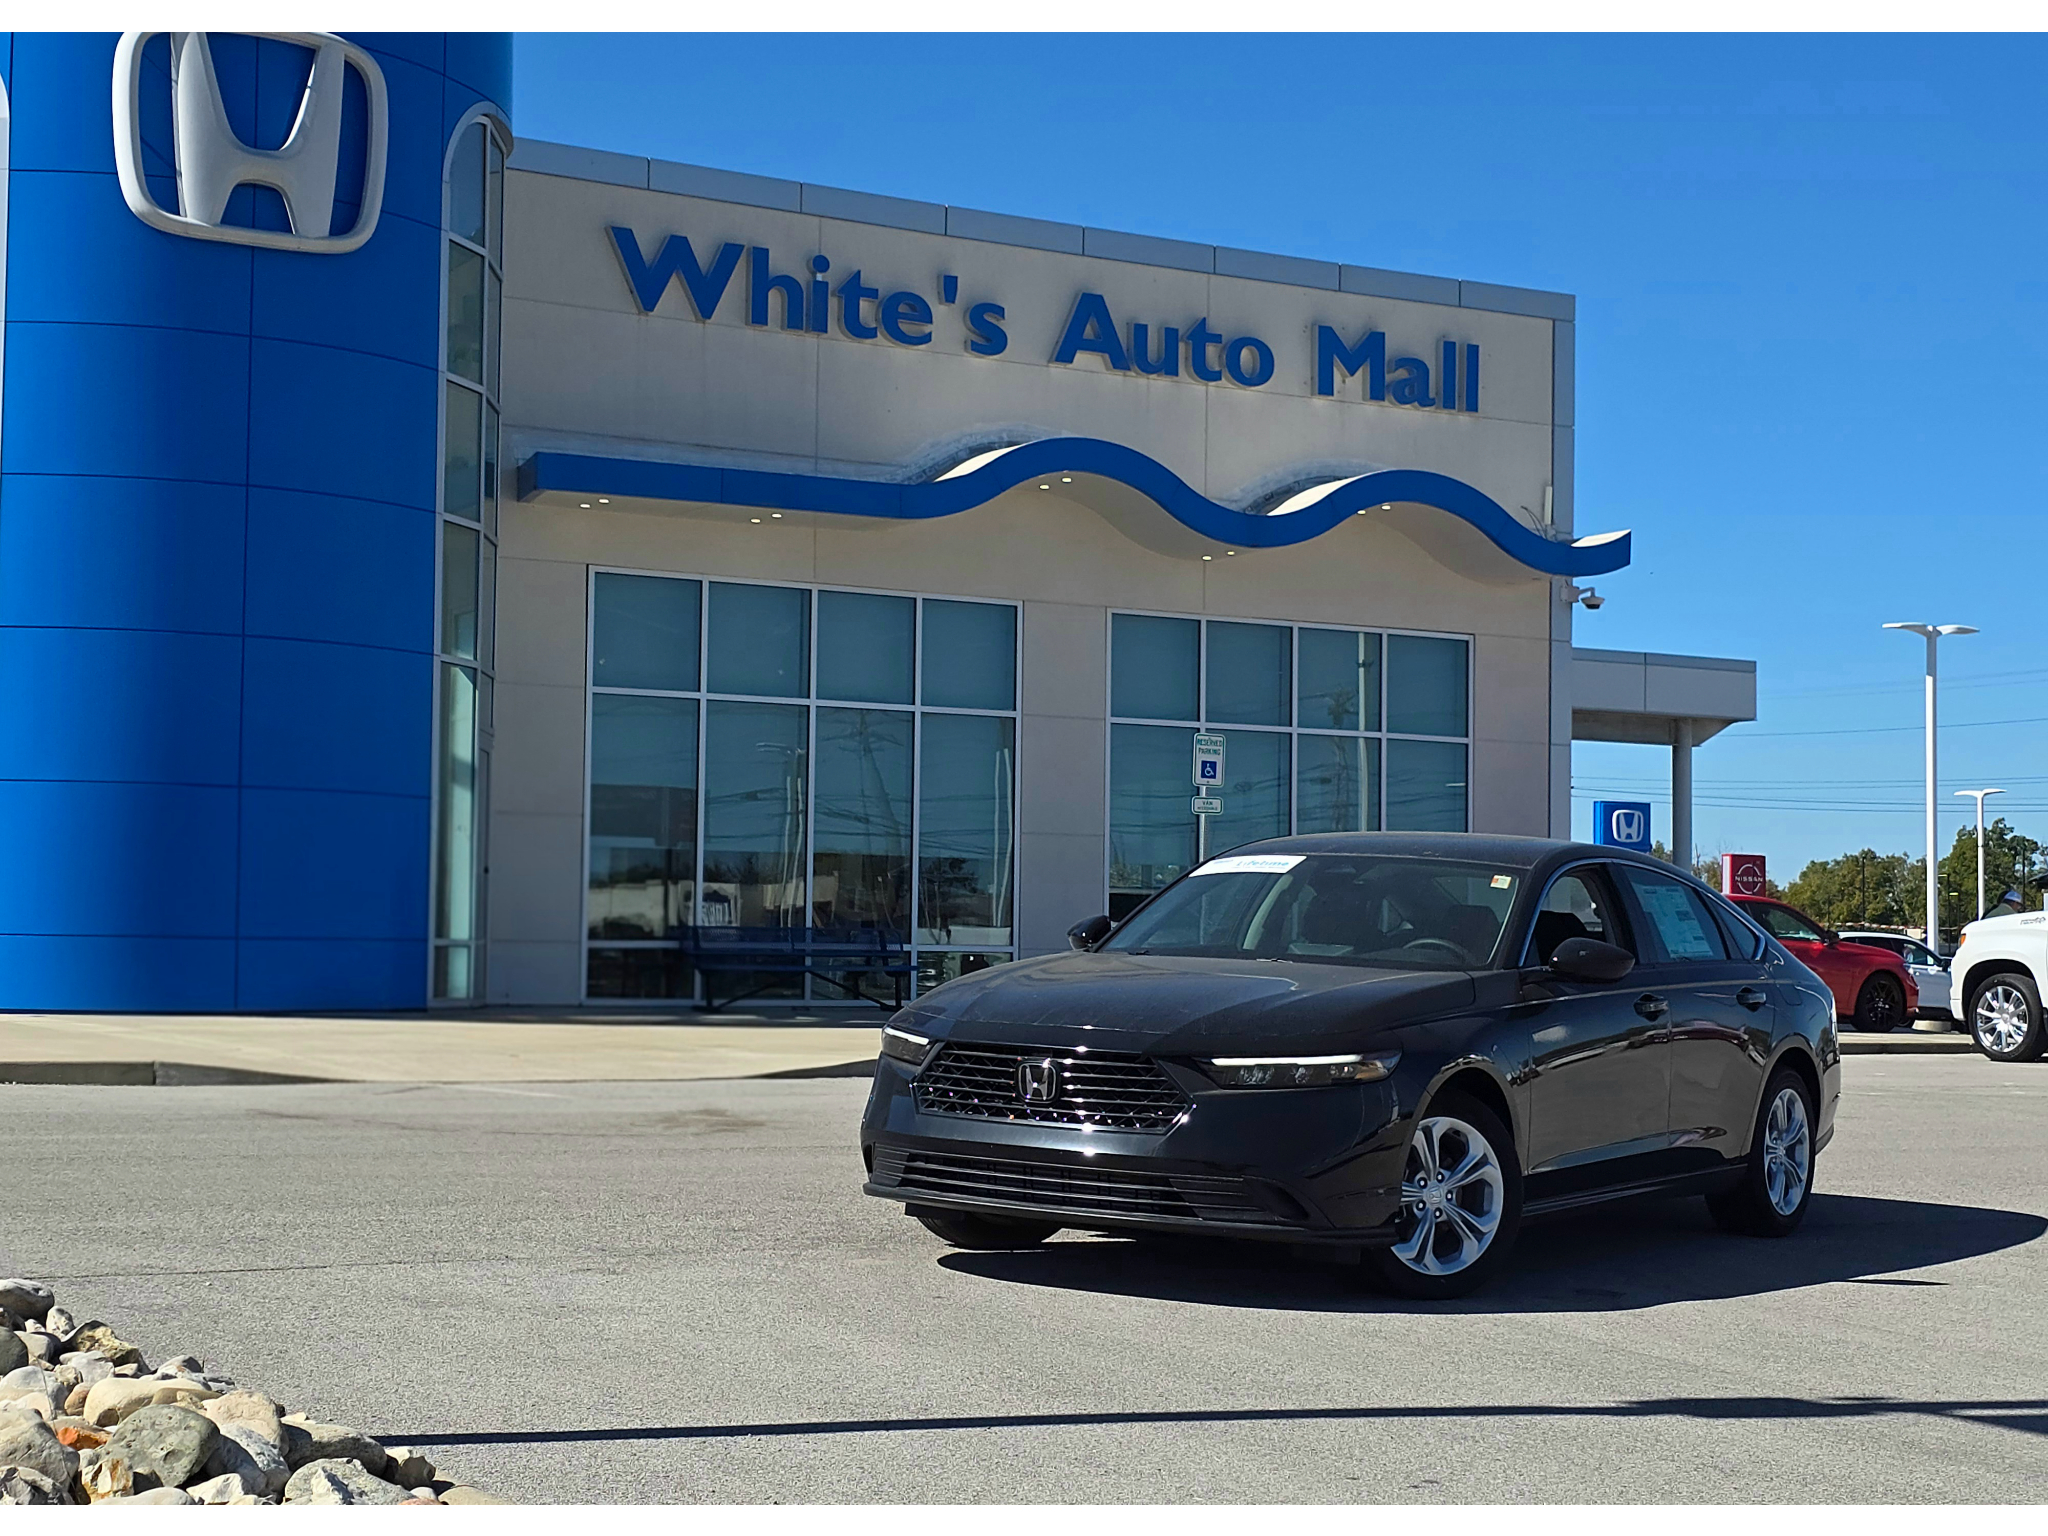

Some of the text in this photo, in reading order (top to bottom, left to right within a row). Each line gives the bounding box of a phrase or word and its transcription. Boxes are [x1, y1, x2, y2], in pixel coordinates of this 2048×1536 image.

[606, 226, 1479, 413] White's Auto Mall
[1197, 738, 1222, 747] RESERVED
[1198, 747, 1221, 756] PARKING
